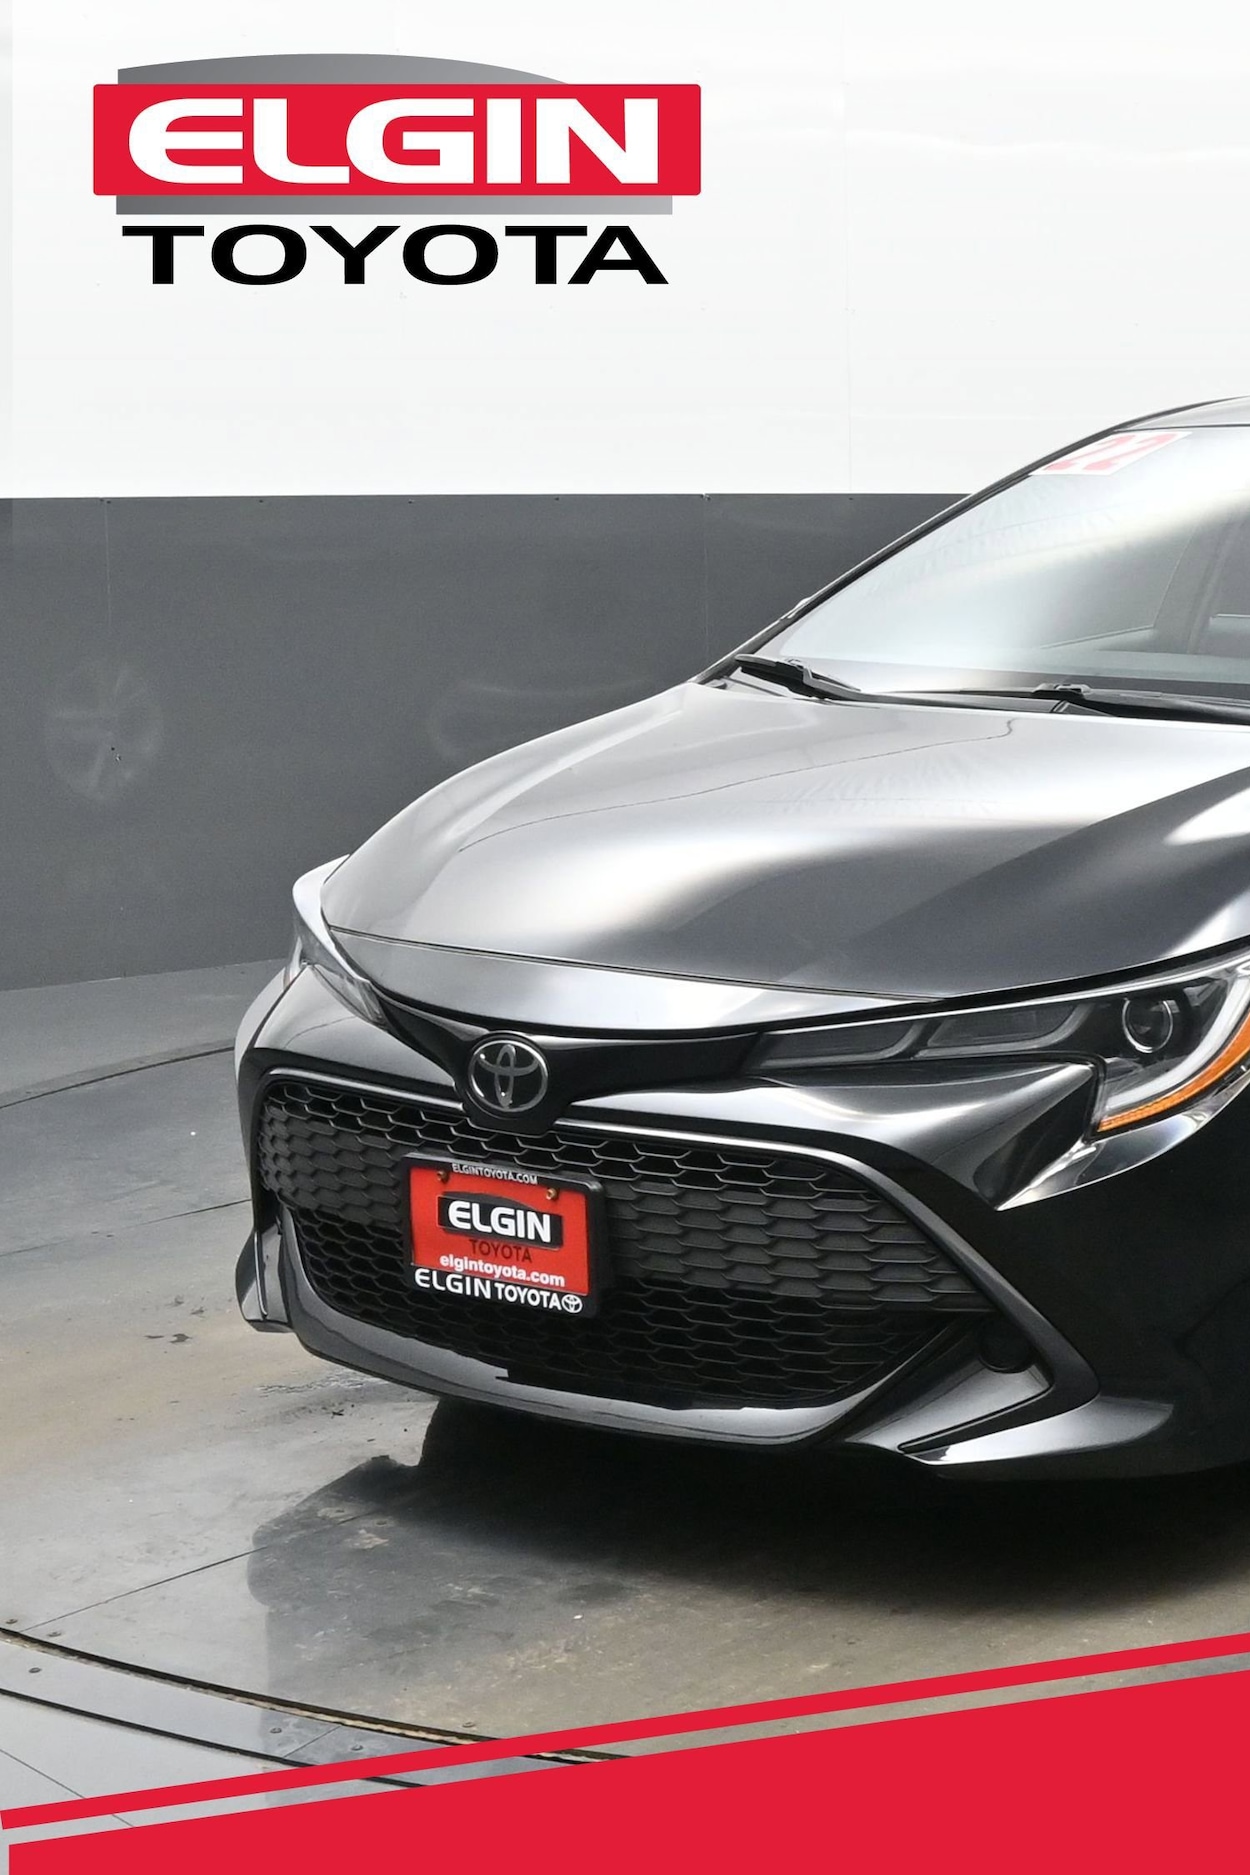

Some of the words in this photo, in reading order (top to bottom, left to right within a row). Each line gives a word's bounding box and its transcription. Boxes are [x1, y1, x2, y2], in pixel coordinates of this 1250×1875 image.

[1042, 433, 1179, 471] 22
[451, 1162, 538, 1185] ELGINTOYOTA.COM
[448, 1200, 551, 1243] ELGIN
[469, 1239, 532, 1262] TOYOTA
[439, 1254, 566, 1287] elgintoyota.com
[414, 1268, 491, 1299] ELGIN
[494, 1282, 562, 1311] TOYOTA
